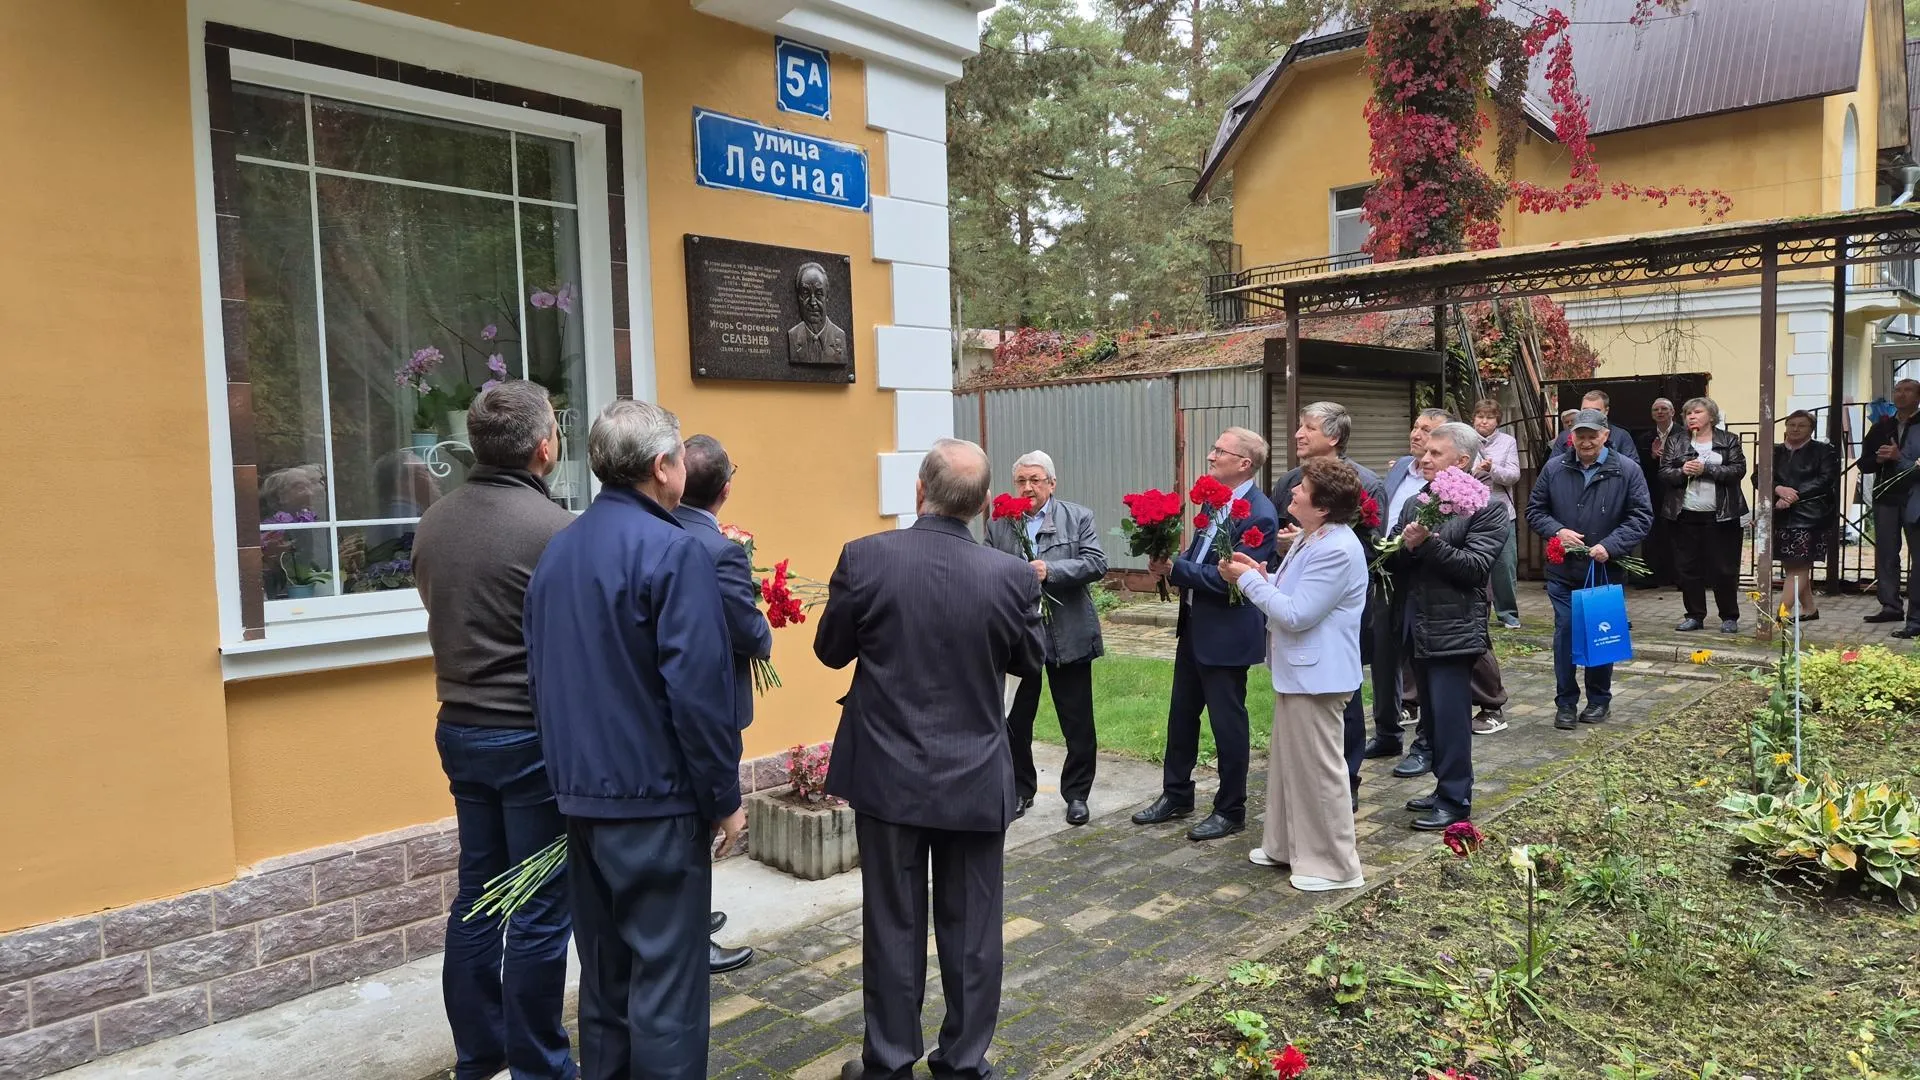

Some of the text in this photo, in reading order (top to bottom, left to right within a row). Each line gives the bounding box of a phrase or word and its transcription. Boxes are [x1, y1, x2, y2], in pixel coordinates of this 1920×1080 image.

[786, 56, 823, 97] 5А
[753, 131, 820, 161] улица
[726, 144, 844, 197] Лесная
[709, 319, 779, 333] Игорь Сергеевич
[721, 333, 769, 346] СЕЛЕЗНЕВ
